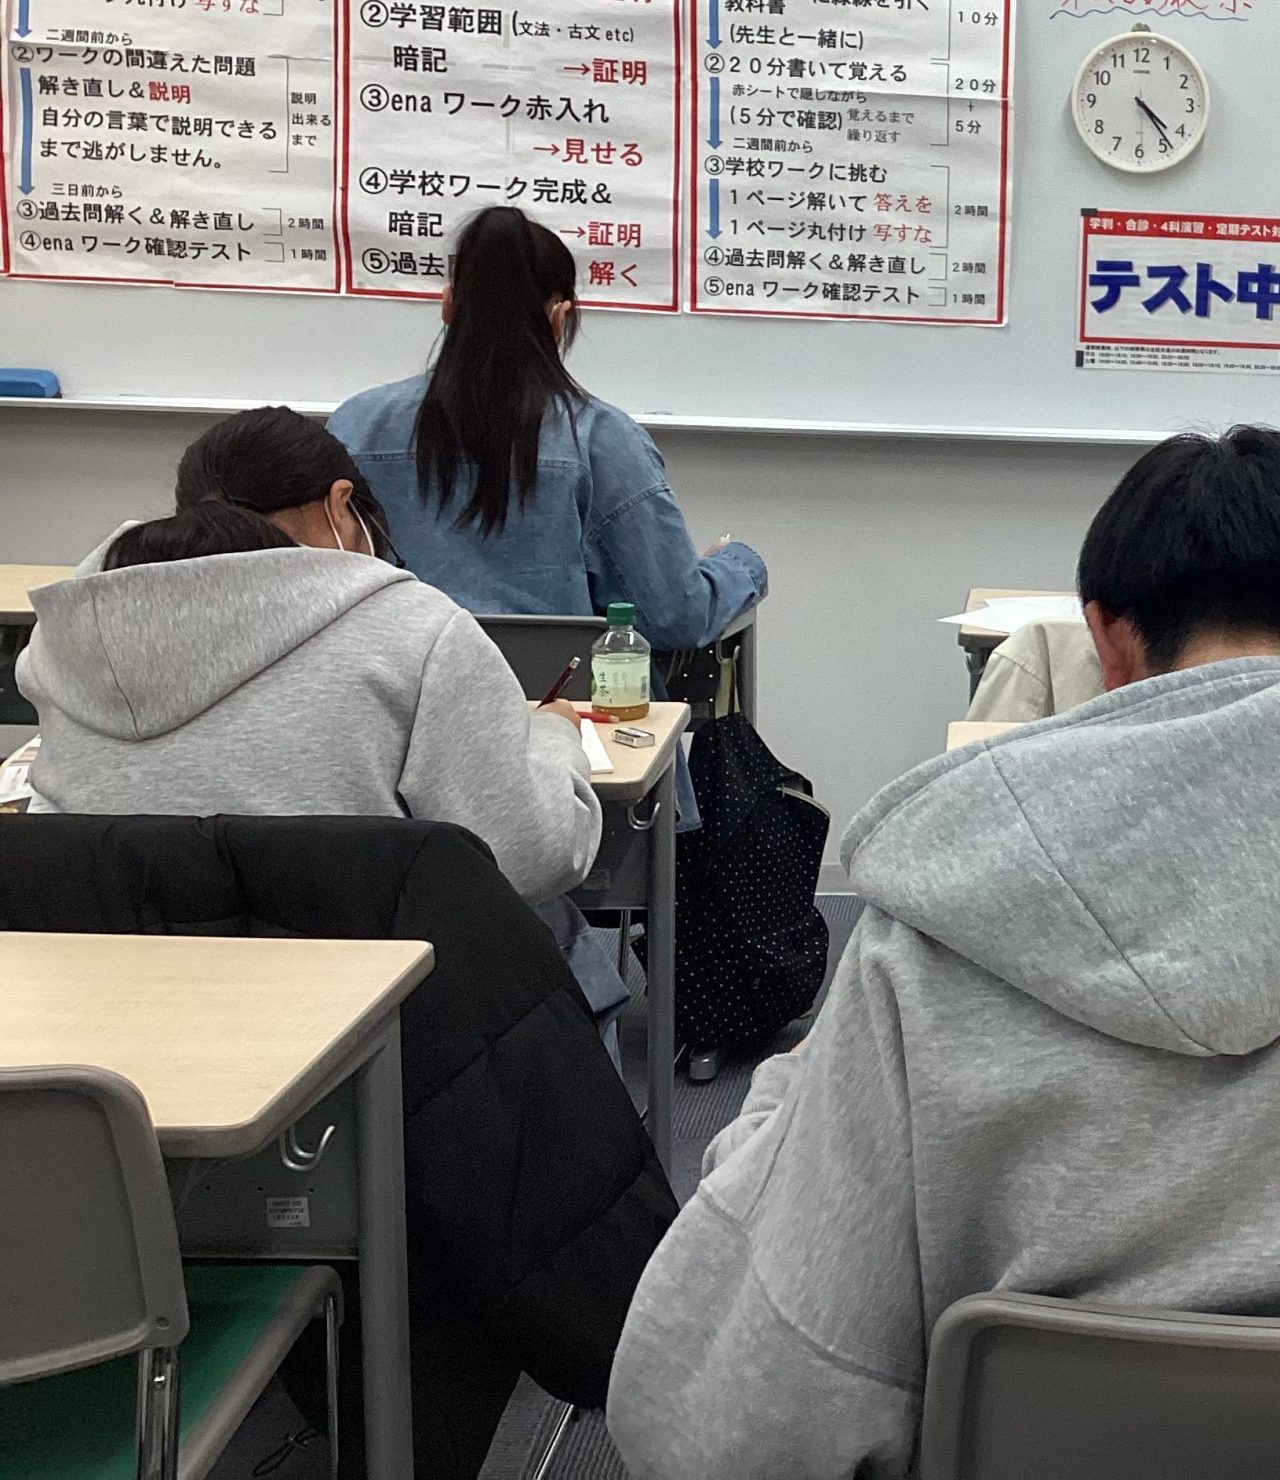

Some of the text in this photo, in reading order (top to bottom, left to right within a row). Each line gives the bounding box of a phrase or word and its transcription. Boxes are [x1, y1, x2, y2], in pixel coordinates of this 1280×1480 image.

[958, 12, 999, 25] 10分
[46, 28, 133, 46] 二週間前から
[730, 24, 864, 50] (先生と一緒に)
[393, 45, 447, 73] 暗記
[1111, 53, 1125, 68] 11
[1133, 48, 1150, 63] 12
[1163, 56, 1169, 70] 1
[955, 78, 997, 93] 20分
[1094, 70, 1111, 86] 10
[1179, 74, 1189, 89] 2
[291, 92, 317, 105] 説明
[731, 84, 867, 104] 赤シートで隠しながら
[1086, 93, 1096, 108] 9
[443, 92, 610, 124] ワーク赤入れ
[1185, 97, 1194, 113] 3
[41, 107, 277, 140] 自分の言葉で説明できる
[292, 113, 332, 127] 出来る
[730, 106, 843, 131] (5分で確認)
[846, 109, 915, 125] 覚えるまで
[955, 120, 981, 134] 5分
[1094, 119, 1104, 134] 8
[1175, 123, 1185, 138] 4
[291, 134, 317, 146] まで
[846, 129, 901, 143] 繰り返す
[1112, 136, 1122, 151] 7
[732, 136, 814, 154] 二週間前から
[1135, 144, 1144, 158] 6
[1158, 138, 1168, 153] 5
[40, 139, 223, 170] まで逃がしません。
[51, 183, 123, 199] 三日前から
[730, 189, 933, 214] 1ページ解いて 答えを
[954, 205, 988, 217] 2時間
[288, 218, 324, 230] 2時間
[388, 211, 444, 238] 暗記
[730, 219, 932, 244] 1ページ丸付け 写すな
[81, 235, 251, 262] ワーク確認テスト
[291, 249, 327, 261] 1時間
[952, 262, 986, 275] 2時間
[762, 281, 920, 305] ワーク確認テスト
[952, 293, 985, 306] 1時間
